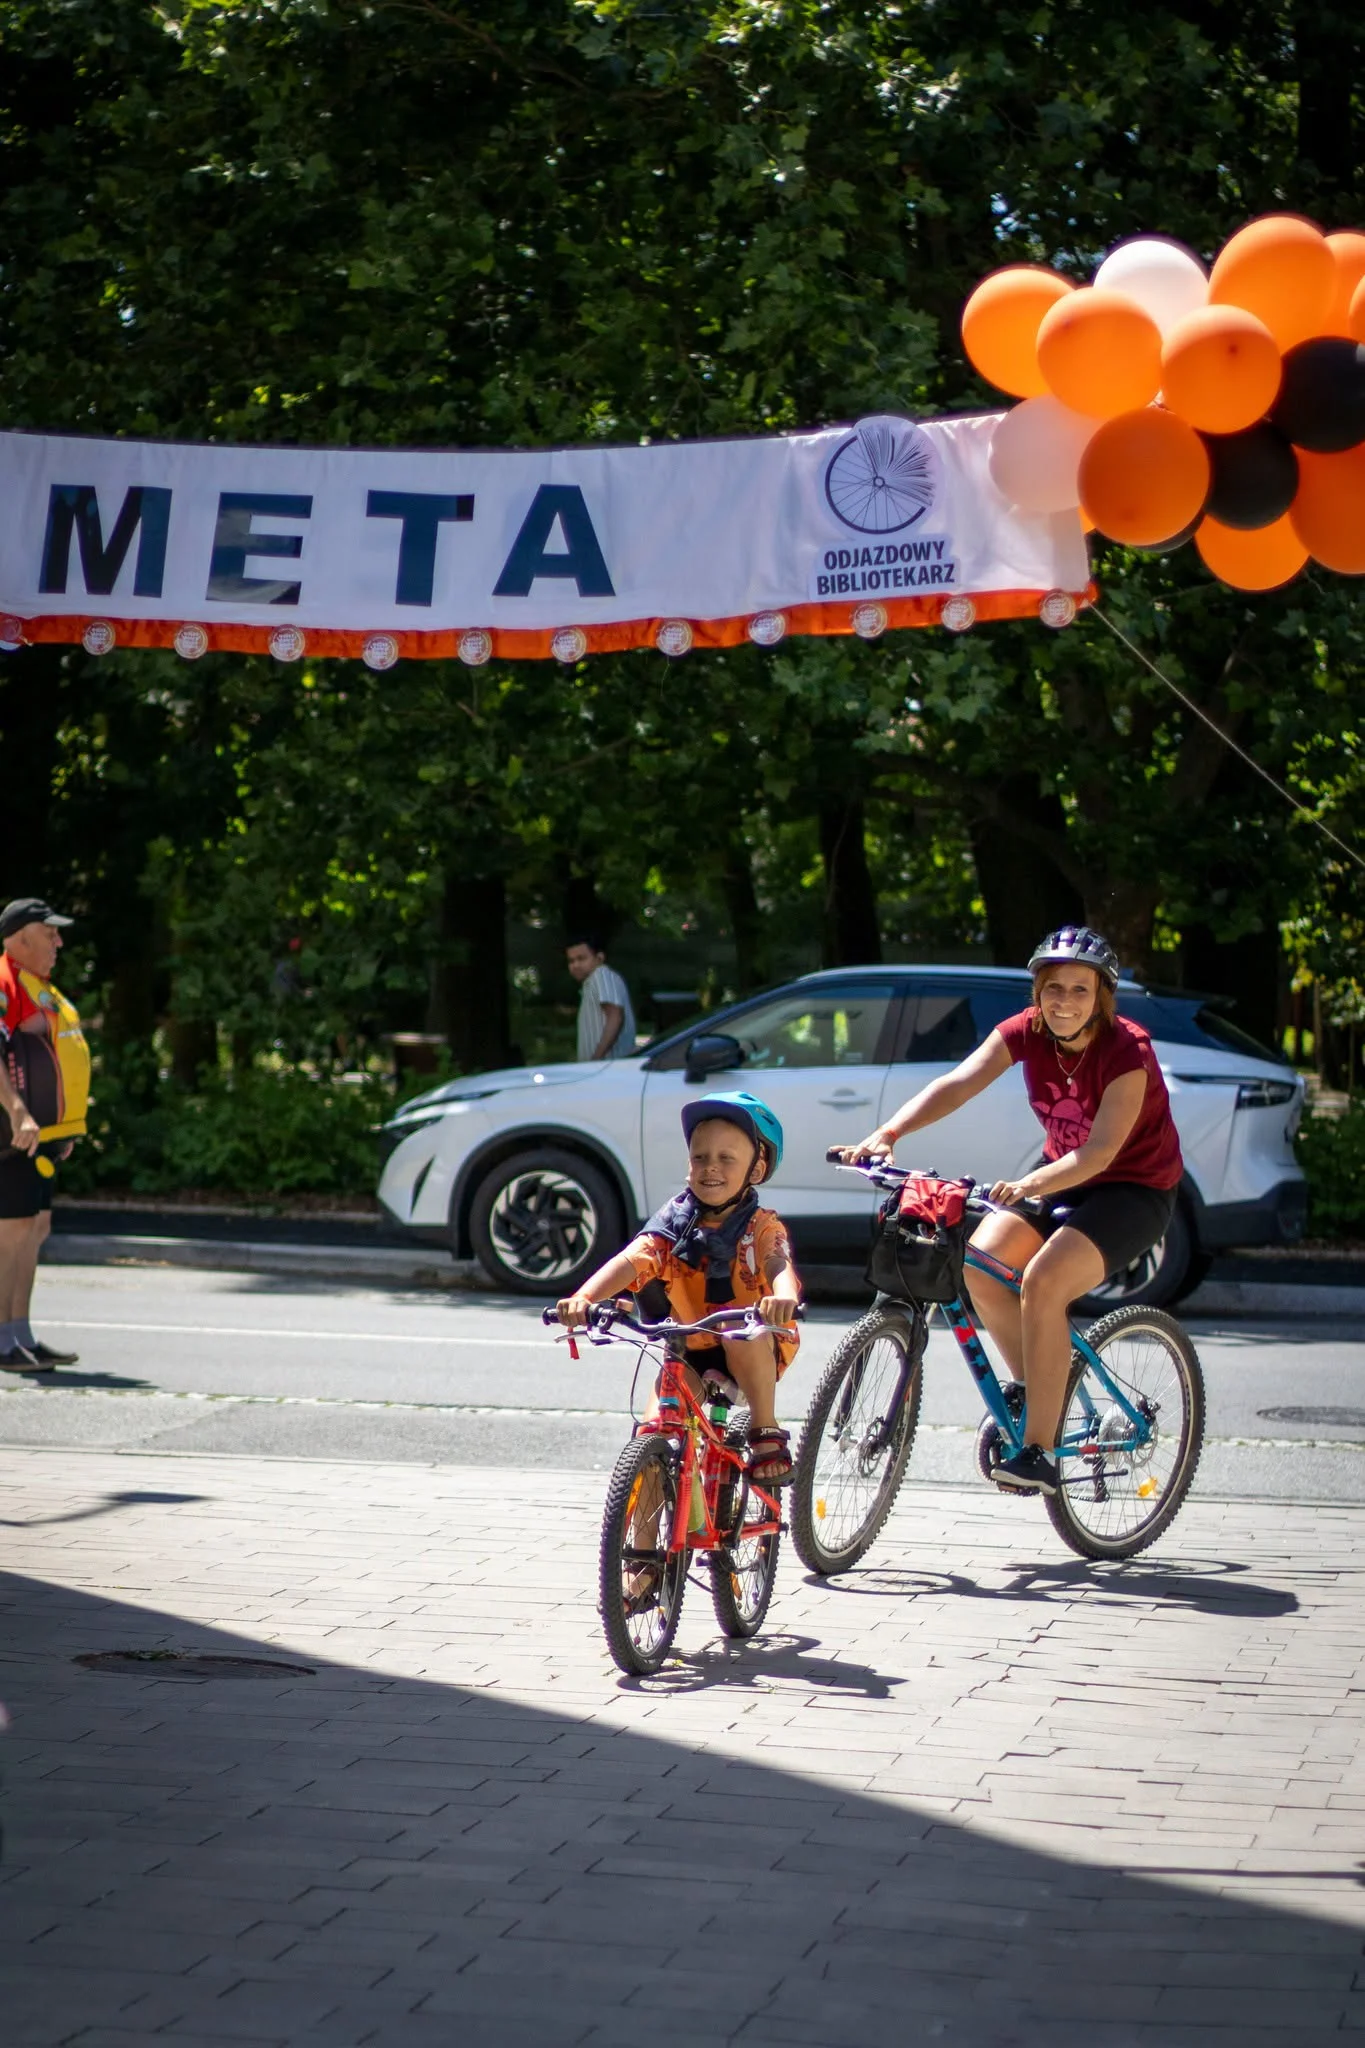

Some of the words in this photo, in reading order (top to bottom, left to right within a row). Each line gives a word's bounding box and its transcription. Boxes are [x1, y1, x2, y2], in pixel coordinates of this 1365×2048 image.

[38, 484, 616, 607] META
[824, 541, 945, 570] ODJAZDOWY
[817, 564, 955, 595] BIBLIOTEKARZ
